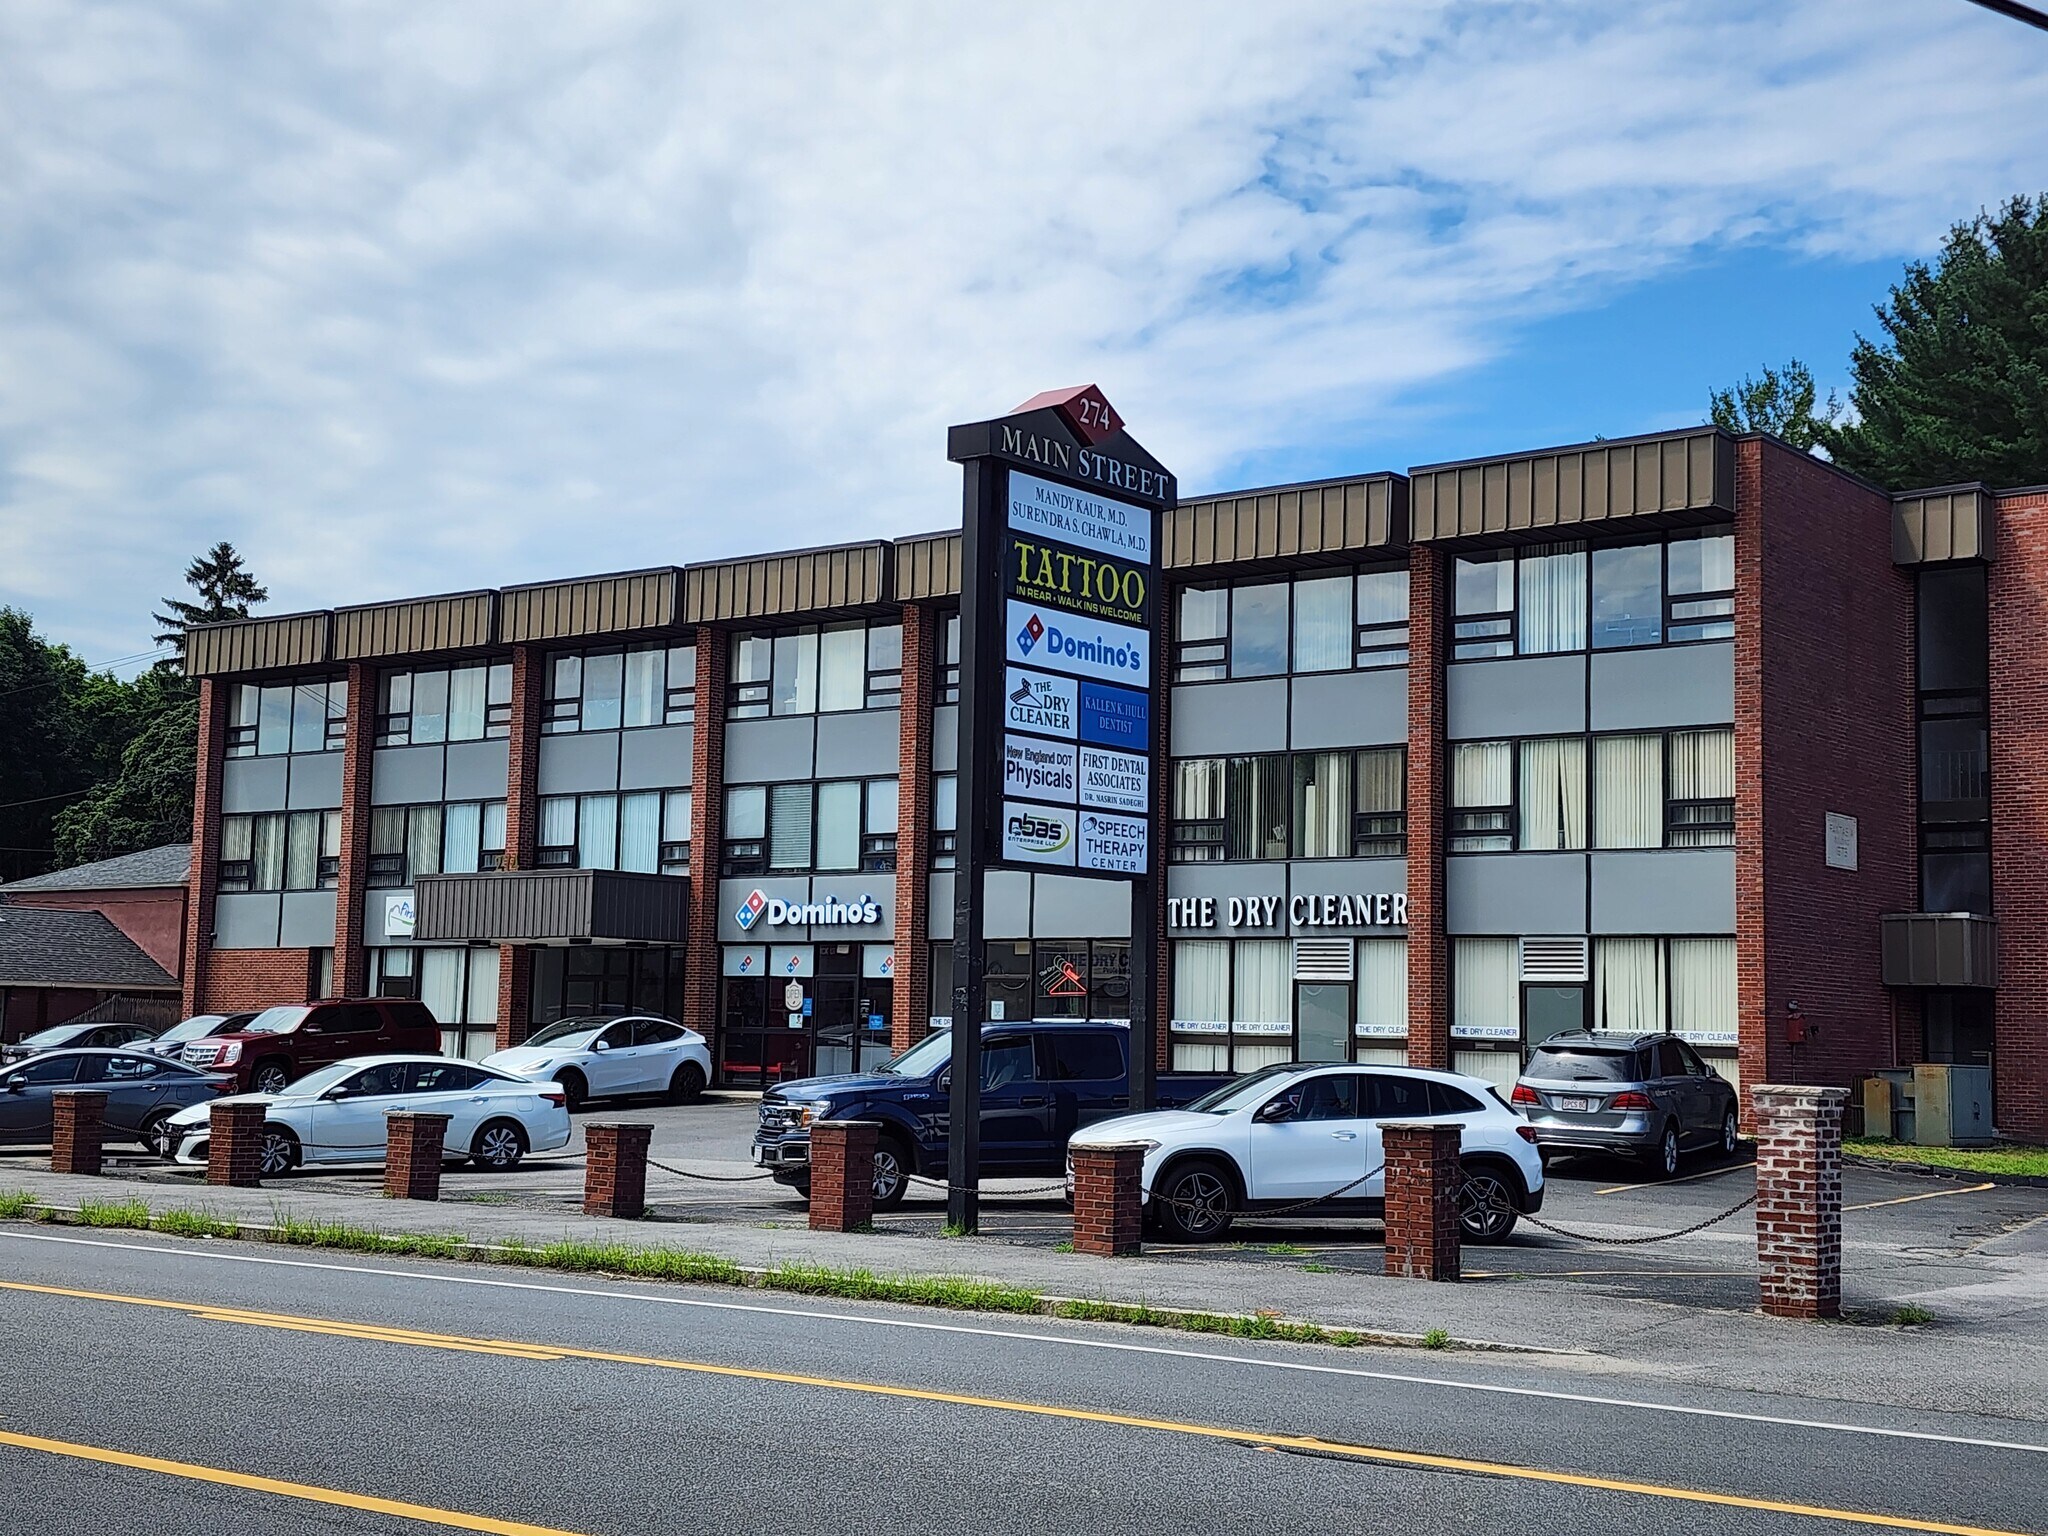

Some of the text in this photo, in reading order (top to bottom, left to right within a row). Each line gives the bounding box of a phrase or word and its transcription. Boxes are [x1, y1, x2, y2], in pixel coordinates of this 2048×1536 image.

[1080, 398, 1110, 430] 274
[1001, 424, 1168, 500] MAIN STREET
[1035, 486, 1128, 527] MANDY KAUR, M.D.
[1012, 501, 1148, 552] SURENDRA S. CHAWLA, M.D.
[1014, 539, 1146, 609] TATTOO
[1016, 585, 1142, 623] IN REAR WALK INS WELCOME
[1047, 626, 1141, 671] Domino's
[1034, 681, 1052, 693] THE
[1044, 694, 1070, 713] DRY
[1085, 696, 1116, 714] KALLEN
[1125, 704, 1146, 720] HULL
[1010, 706, 1070, 730] CLEANER
[1100, 716, 1133, 734] DENTIST
[1006, 744, 1072, 766] New England DOT
[1083, 752, 1146, 776] FIRST DENTAL
[1006, 760, 1073, 790] Physicals
[1087, 771, 1142, 792] ASSOCIATES
[1084, 793, 1144, 808] DR. NASRIN SADEGHI
[1098, 820, 1145, 840] SPEECH
[1086, 838, 1145, 858] THERAPY
[1091, 857, 1136, 871] CENTER
[767, 894, 882, 926] Domino's
[1168, 892, 1408, 928] THE DRY CLEANER
[1174, 1022, 1227, 1031] THE DRY CLEANER
[1263, 1024, 1290, 1032] CLEANER
[1372, 1026, 1386, 1034] DRY
[1470, 1028, 1484, 1036] DRY
[1486, 1028, 1517, 1036] CLEANER
